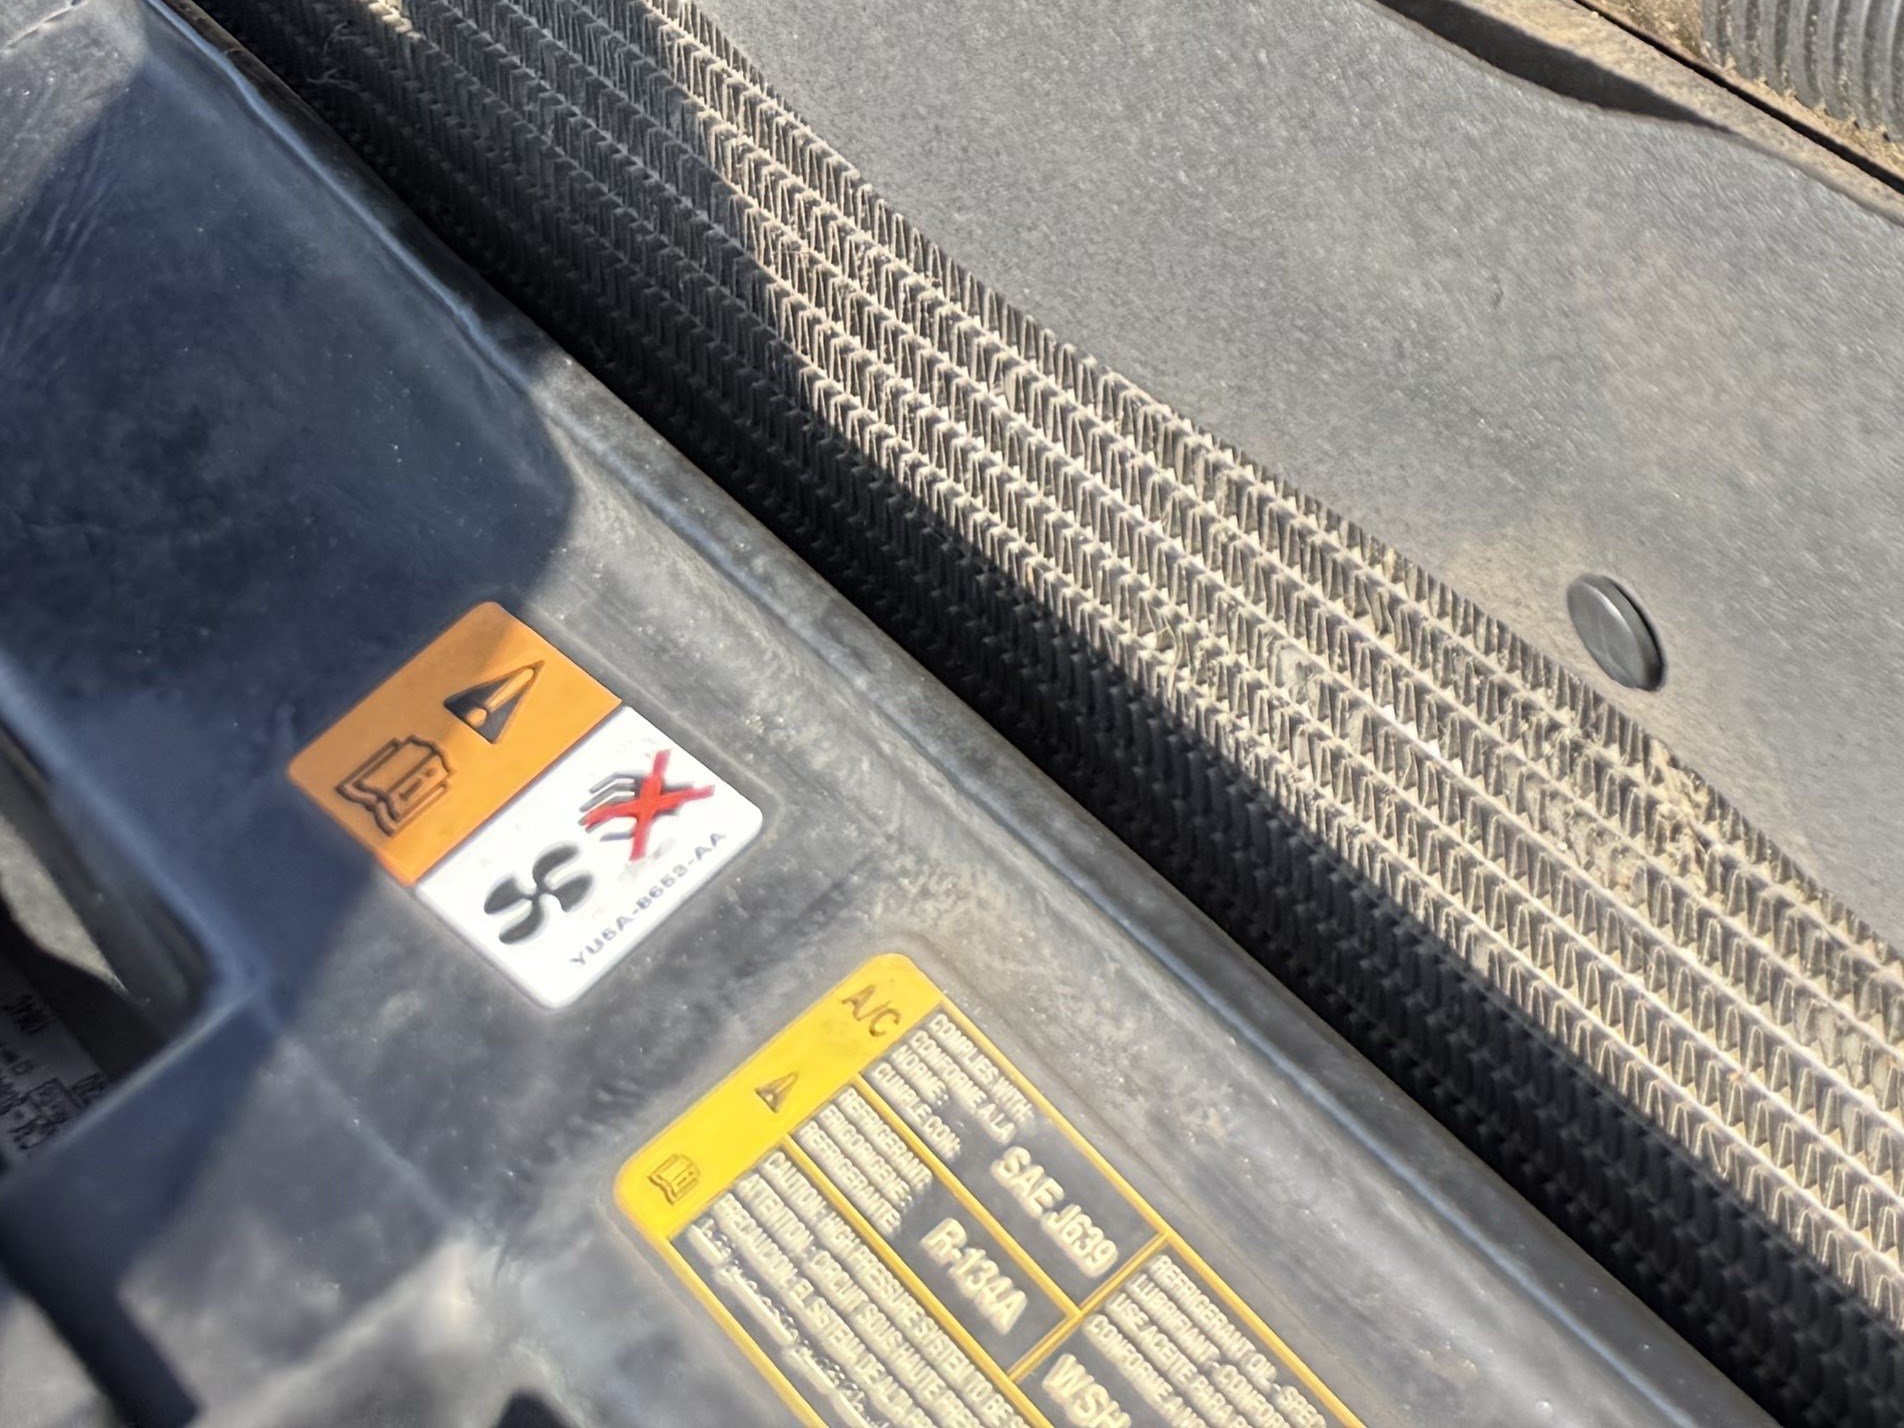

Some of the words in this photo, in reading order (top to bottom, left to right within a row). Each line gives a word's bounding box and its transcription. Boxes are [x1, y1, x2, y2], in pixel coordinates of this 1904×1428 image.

[841, 984, 901, 1037] A/C
[986, 1141, 1068, 1222] SAE
[1037, 1194, 1125, 1282] J639
[918, 1213, 1037, 1336] R-134A
